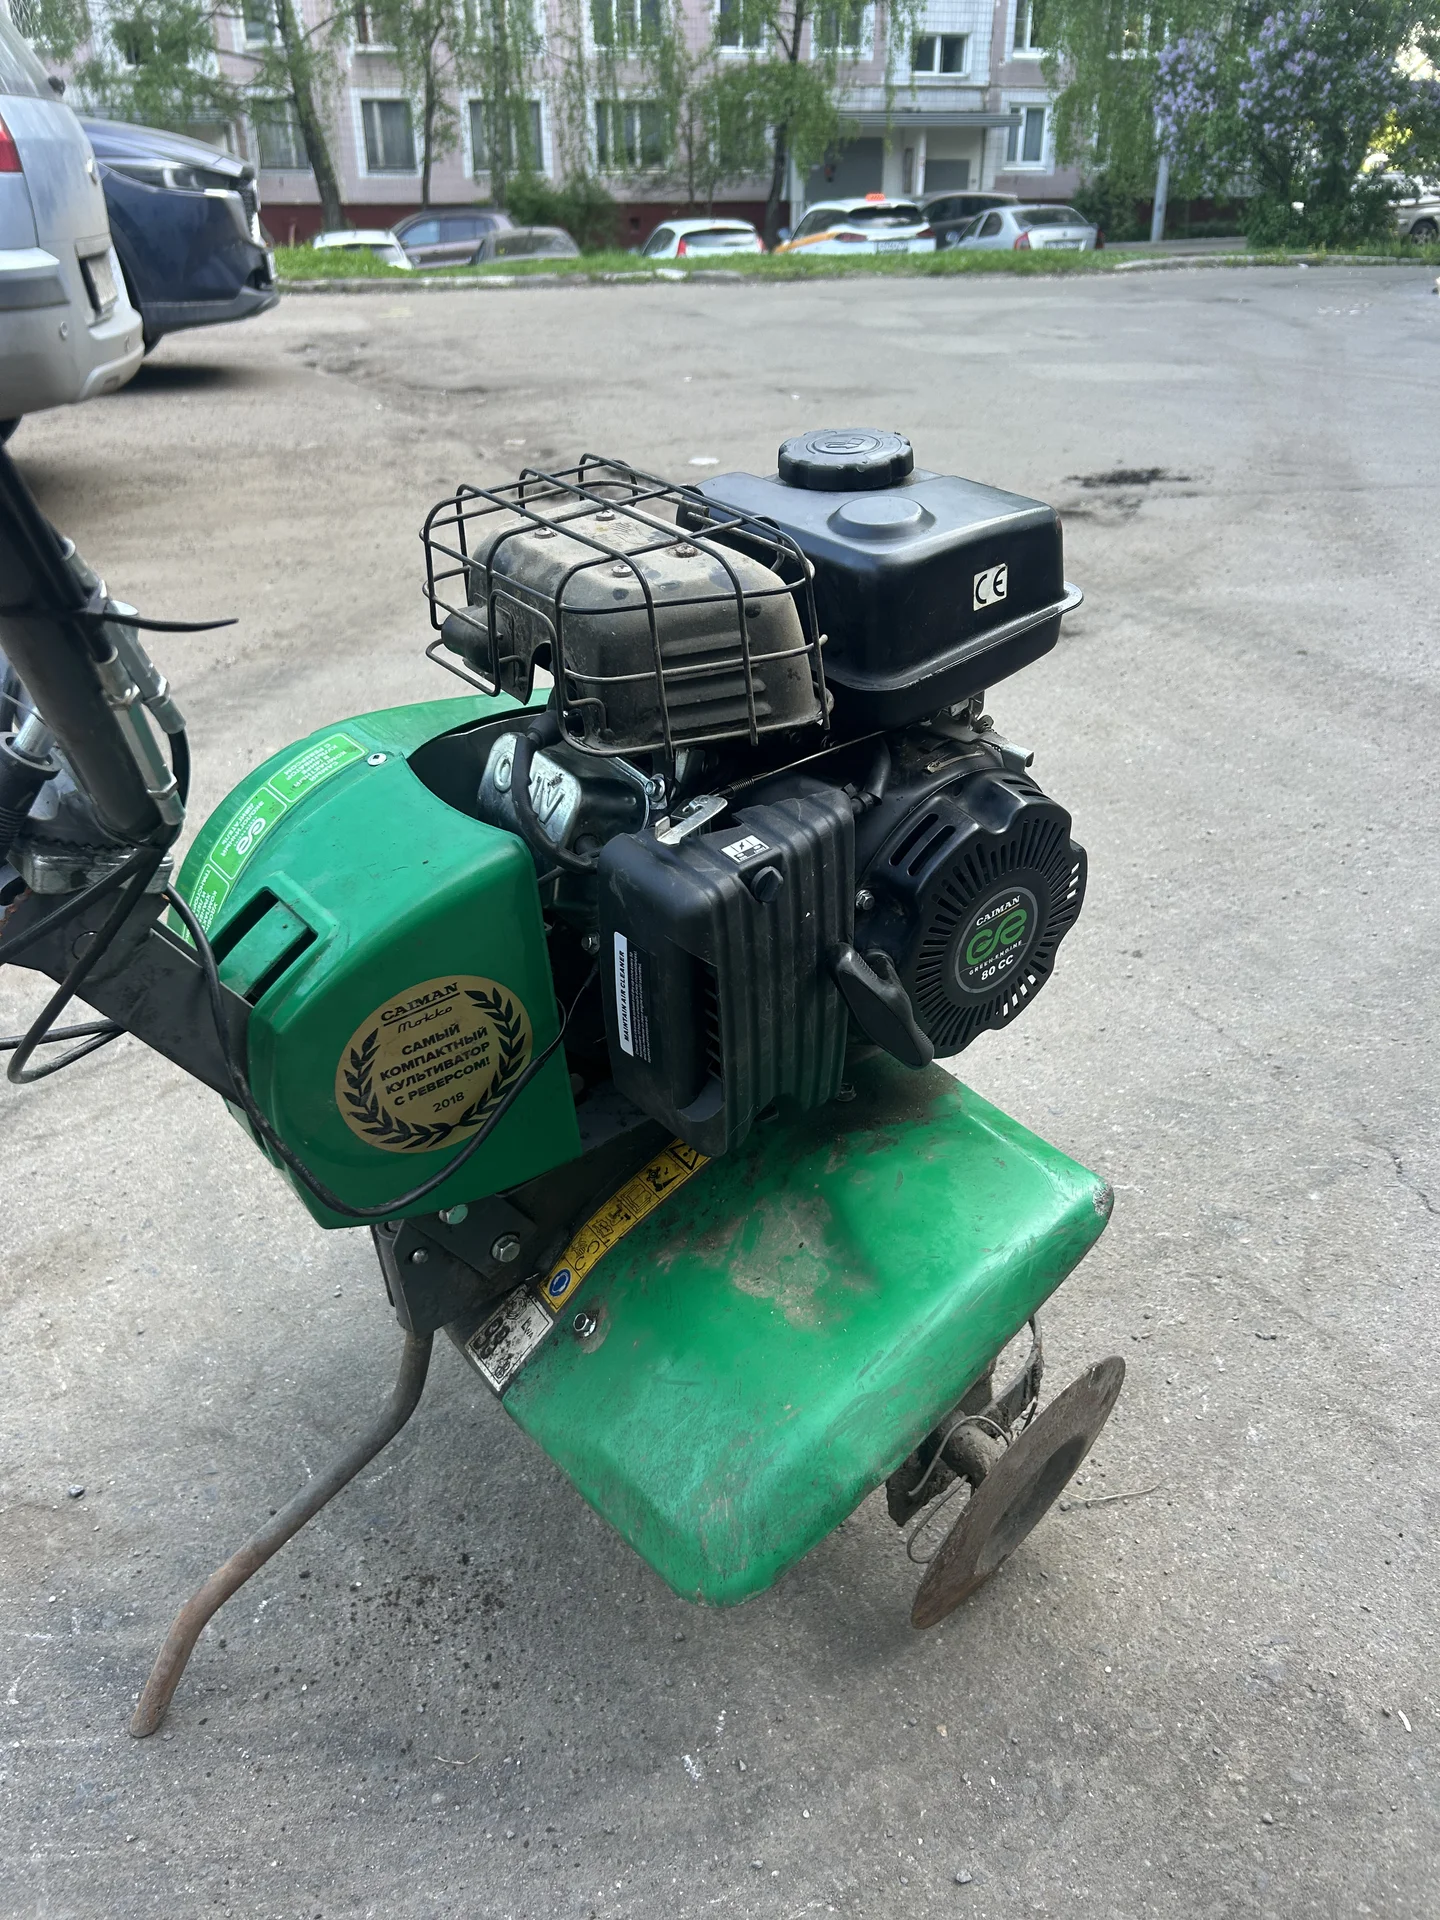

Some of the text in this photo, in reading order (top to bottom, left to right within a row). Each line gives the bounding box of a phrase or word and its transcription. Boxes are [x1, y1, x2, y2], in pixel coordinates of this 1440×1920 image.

[975, 566, 1005, 604] CE
[283, 746, 323, 776] РЕВЕРСОМ
[285, 743, 337, 781] КУЛЬТИВАТОР
[293, 749, 346, 788] КОМПАКТНЫЙ
[308, 760, 338, 783] САМЫЙ
[220, 801, 255, 845] ДВИГАТЕЛЬ
[220, 799, 264, 857] ЭКОЛОГИЧНЫЙ
[200, 890, 217, 930] КОМПАКТ
[203, 901, 217, 933] УДОБН
[976, 895, 1021, 927] CAIMAN
[981, 954, 1014, 981] 80 CC
[380, 982, 459, 1022] CAIMAN
[401, 1023, 461, 1056] САМЫЙ
[621, 1003, 629, 1042] MAINTAIN
[380, 1026, 489, 1081] КОМПАКТНЫЙ
[386, 1041, 490, 1095] КУЛЬТИВАТОР
[393, 1056, 491, 1106] С РЕВЕРСОМ!
[432, 1091, 465, 1113] 2018
